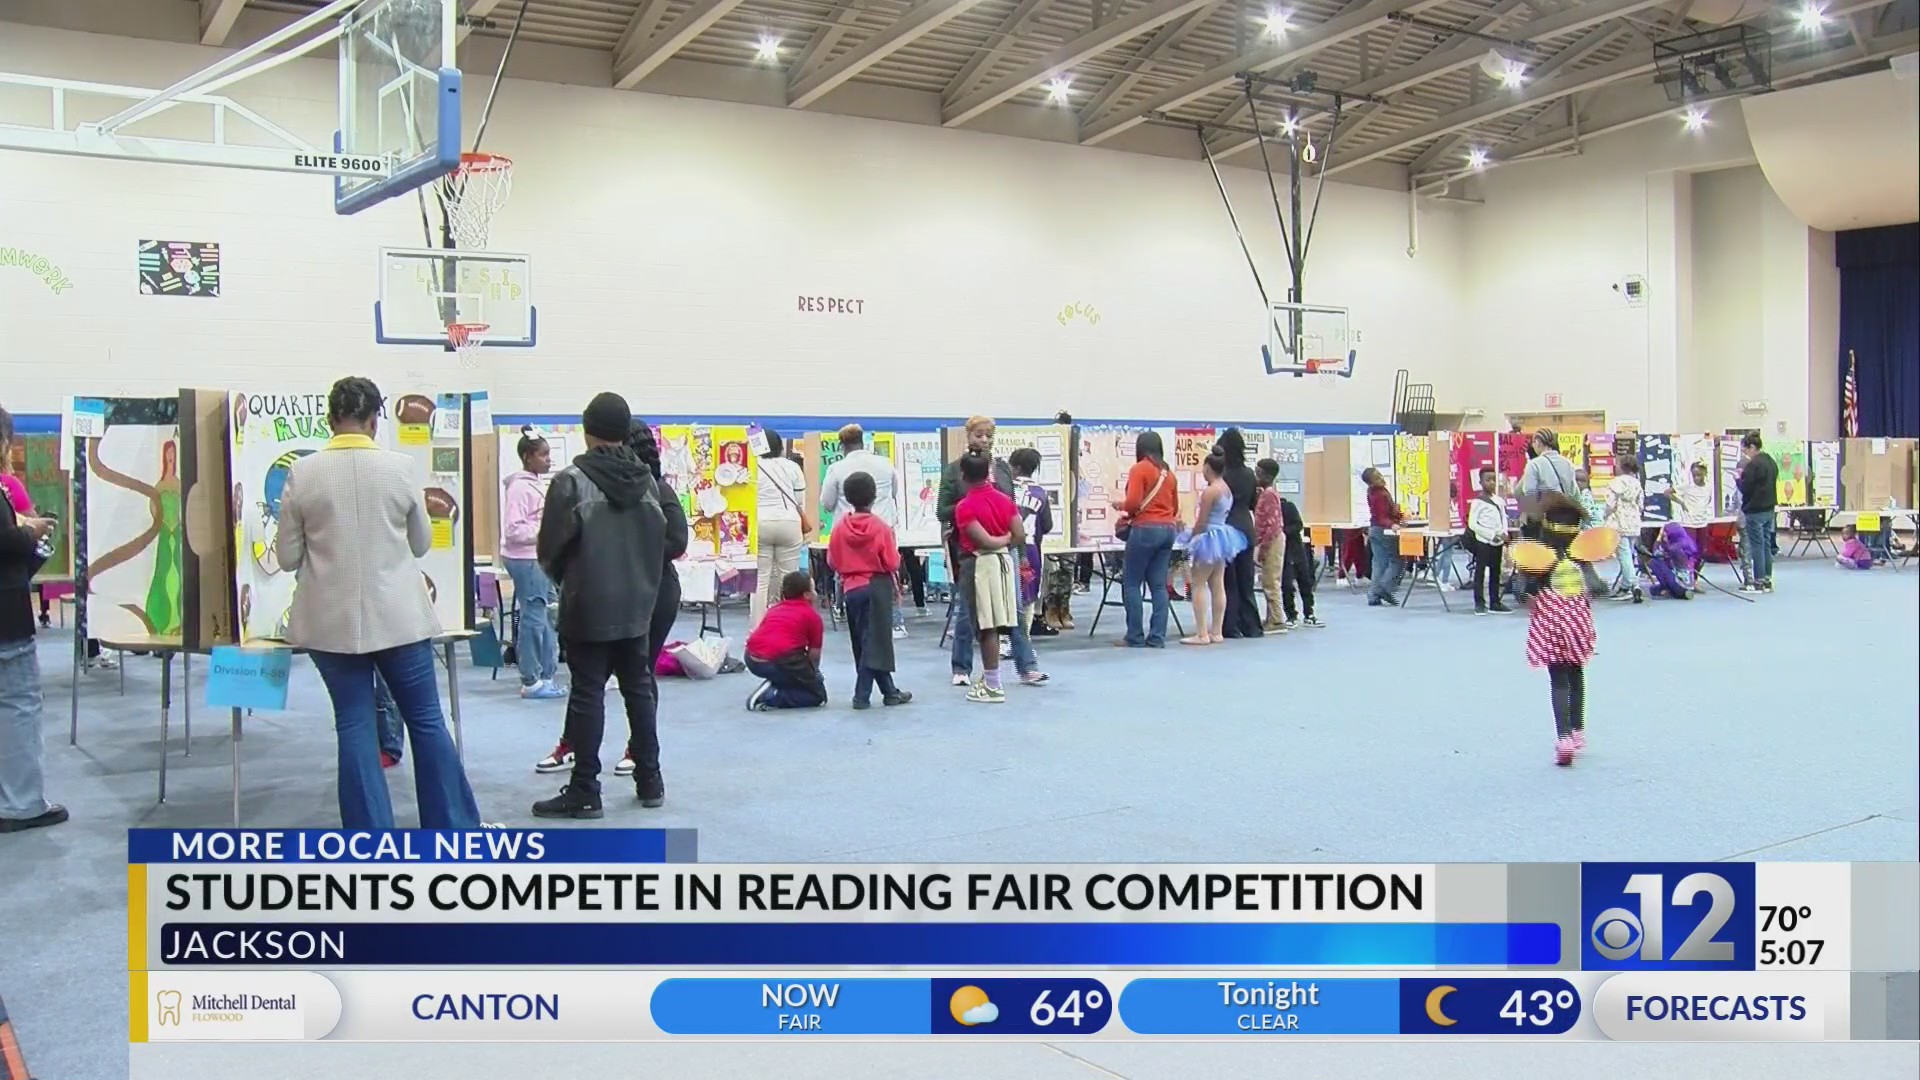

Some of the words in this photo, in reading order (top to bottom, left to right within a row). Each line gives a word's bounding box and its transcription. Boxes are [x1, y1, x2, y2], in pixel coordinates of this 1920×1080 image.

[294, 155, 337, 169] ELITE
[341, 158, 381, 171] 9600
[798, 295, 864, 314] RESPECT
[1057, 301, 1101, 326] FOCUS
[214, 664, 257, 678] Division
